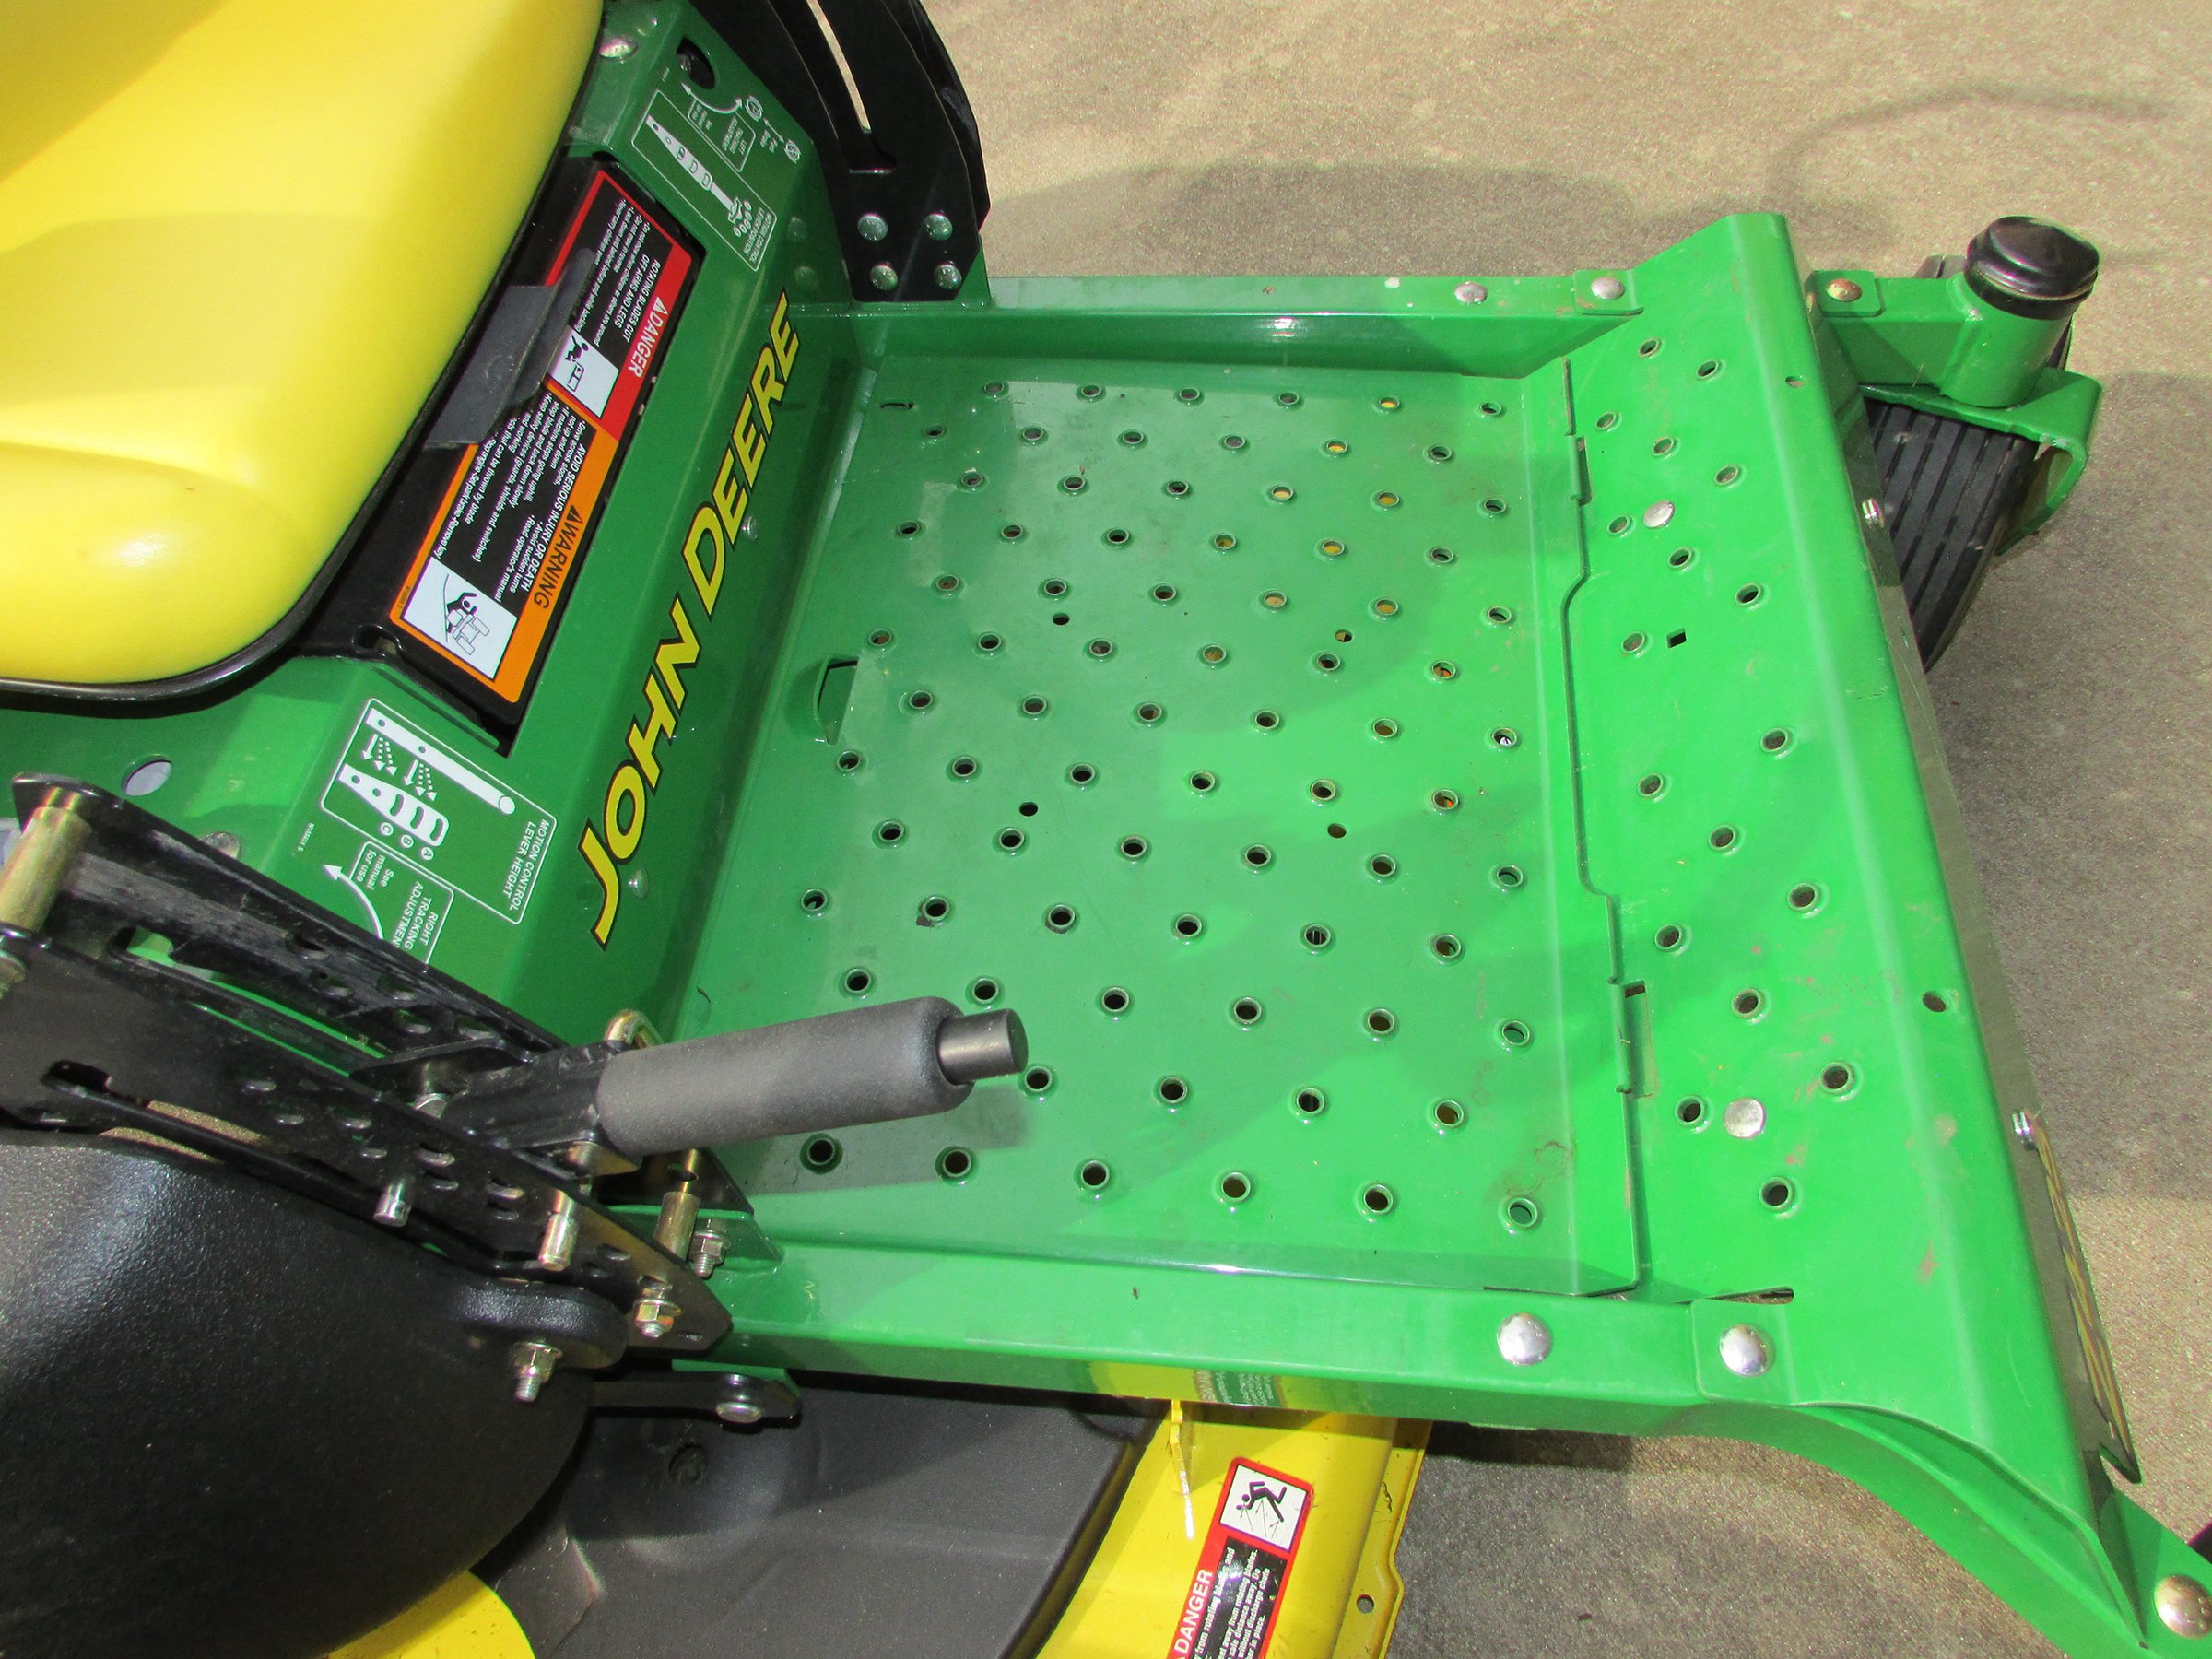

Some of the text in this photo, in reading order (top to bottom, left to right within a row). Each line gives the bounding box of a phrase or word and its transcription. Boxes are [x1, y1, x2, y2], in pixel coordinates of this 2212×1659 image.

[606, 212, 619, 231] carry
[614, 199, 627, 219] Never
[633, 215, 642, 228] Do
[753, 206, 765, 229] LEVER
[598, 228, 614, 253] children
[624, 231, 634, 248] mow
[629, 222, 639, 236] not
[638, 230, 647, 244] not
[641, 222, 651, 235] Do
[742, 225, 758, 256] POSITION
[612, 235, 622, 250] and
[621, 244, 629, 255] in
[632, 239, 642, 256] mow
[748, 234, 764, 264] CONTROL
[604, 245, 618, 268] behind
[625, 253, 637, 272] when
[595, 264, 609, 286] before
[616, 267, 631, 293] children
[584, 291, 597, 312] while
[591, 281, 602, 297] and
[613, 253, 650, 329] OFF ARMS AND LEGS
[613, 288, 621, 299] or
[621, 258, 661, 343] ROTATING BLADES CUT
[572, 305, 590, 334] backing
[601, 312, 610, 326] are
[593, 322, 607, 347] around
[627, 309, 664, 380] DANGER
[500, 429, 512, 447] that
[507, 410, 533, 455] and working
[548, 414, 577, 471] not up and down
[472, 448, 489, 475] engine
[488, 456, 500, 471] be
[493, 442, 505, 460] can
[507, 398, 560, 510] stop blade and back down slowly
[522, 406, 570, 504] If machine stops going uphill,
[551, 421, 586, 489] Drive across slopes,
[459, 480, 475, 501] park
[470, 392, 553, 564] Keep safety devices (guards, shields and switches)
[477, 465, 496, 496] thrown
[453, 496, 469, 520] brake
[471, 489, 485, 506] by
[464, 501, 480, 526] blade
[520, 442, 587, 593] AVOID SERIOUS INJURY OR DEATH
[431, 541, 447, 560] key
[493, 515, 535, 603] Read operator's manual
[508, 523, 544, 594] Avoid sudden turns
[532, 518, 580, 611] WARNING
[579, 286, 800, 950] JOHN DEERE
[355, 847, 377, 883] for use
[365, 853, 386, 890] manual
[500, 819, 537, 899] LEVER HEIGHT
[508, 818, 550, 914] MOTION CONTROL
[379, 867, 394, 888] See
[390, 879, 424, 948] ADJUSTMEN
[402, 894, 432, 951] TRACKING
[418, 910, 439, 946] RIGHT
[1222, 1546, 1235, 1565] and
[1242, 1547, 1258, 1577] blades.
[1251, 1566, 1261, 1580] Do
[1233, 1575, 1251, 1607] rotating
[1244, 1579, 1259, 1605] away.
[1172, 1567, 1213, 1654] DANGER
[1200, 1594, 1222, 1631] rotating
[1227, 1606, 1240, 1627] from
[1233, 1603, 1250, 1639] distance
[1236, 1627, 1252, 1659] without
[1245, 1588, 1265, 1629] discharge
[1258, 1566, 1271, 1590] chute
[1221, 1625, 1236, 1648] away
[1252, 1612, 1266, 1640] place.
[1194, 1630, 1209, 1654] from
[1227, 1636, 1240, 1657] safe
[1248, 1637, 1258, 1648] in
